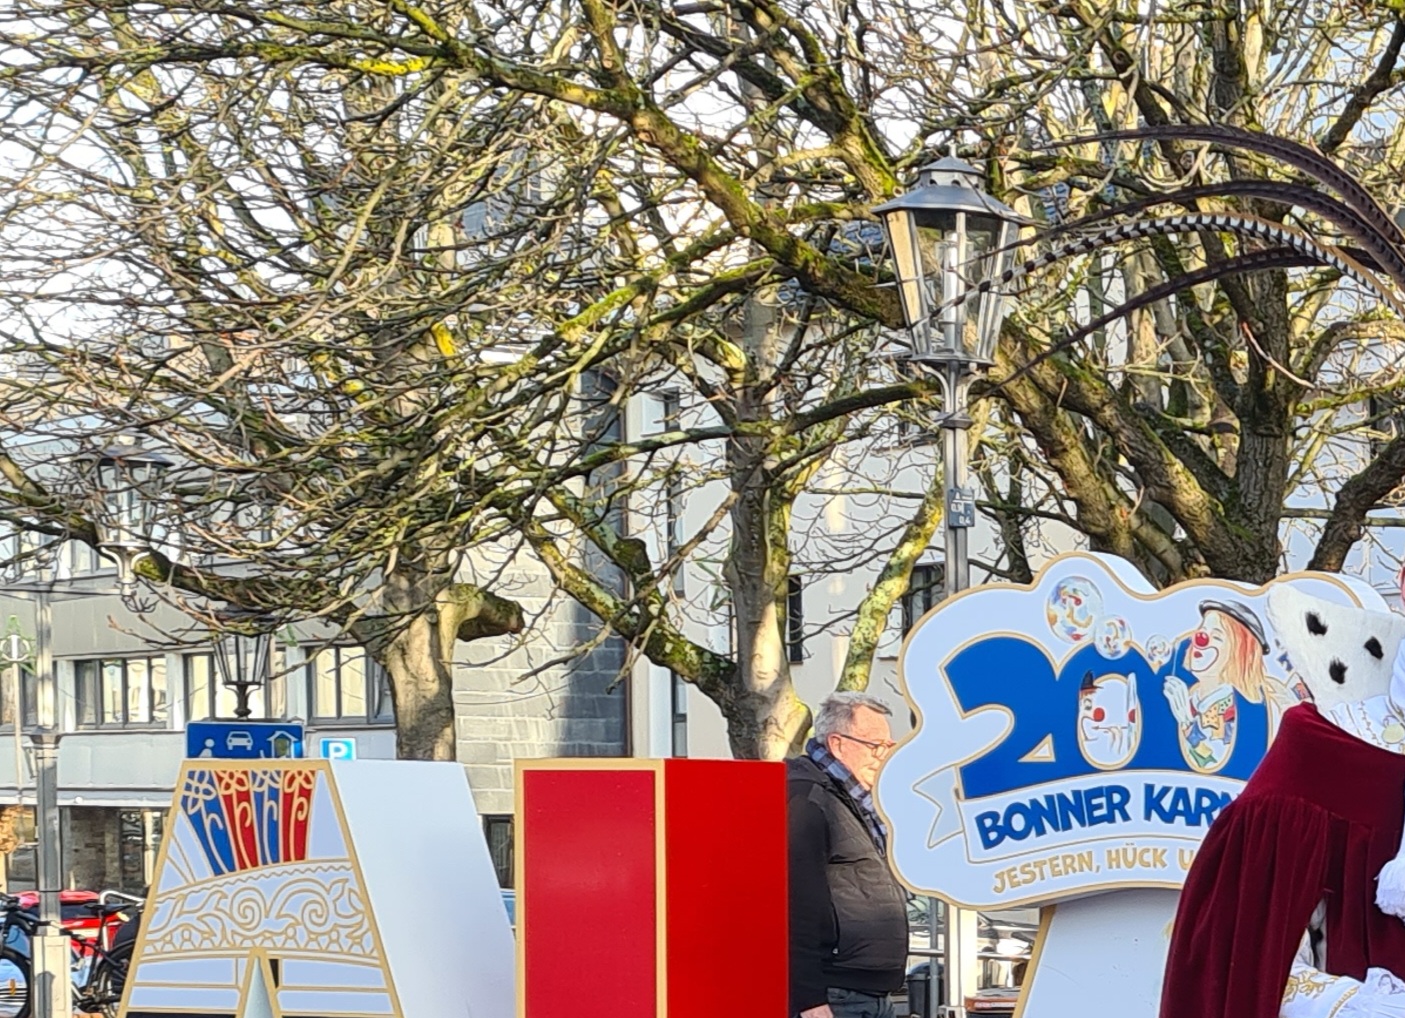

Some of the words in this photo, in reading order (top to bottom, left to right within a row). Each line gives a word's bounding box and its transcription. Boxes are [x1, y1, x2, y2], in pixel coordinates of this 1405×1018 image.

[974, 785, 1131, 850] BONNER
[993, 849, 1100, 893] JESTERN,
[1107, 842, 1168, 869] HÜCK
